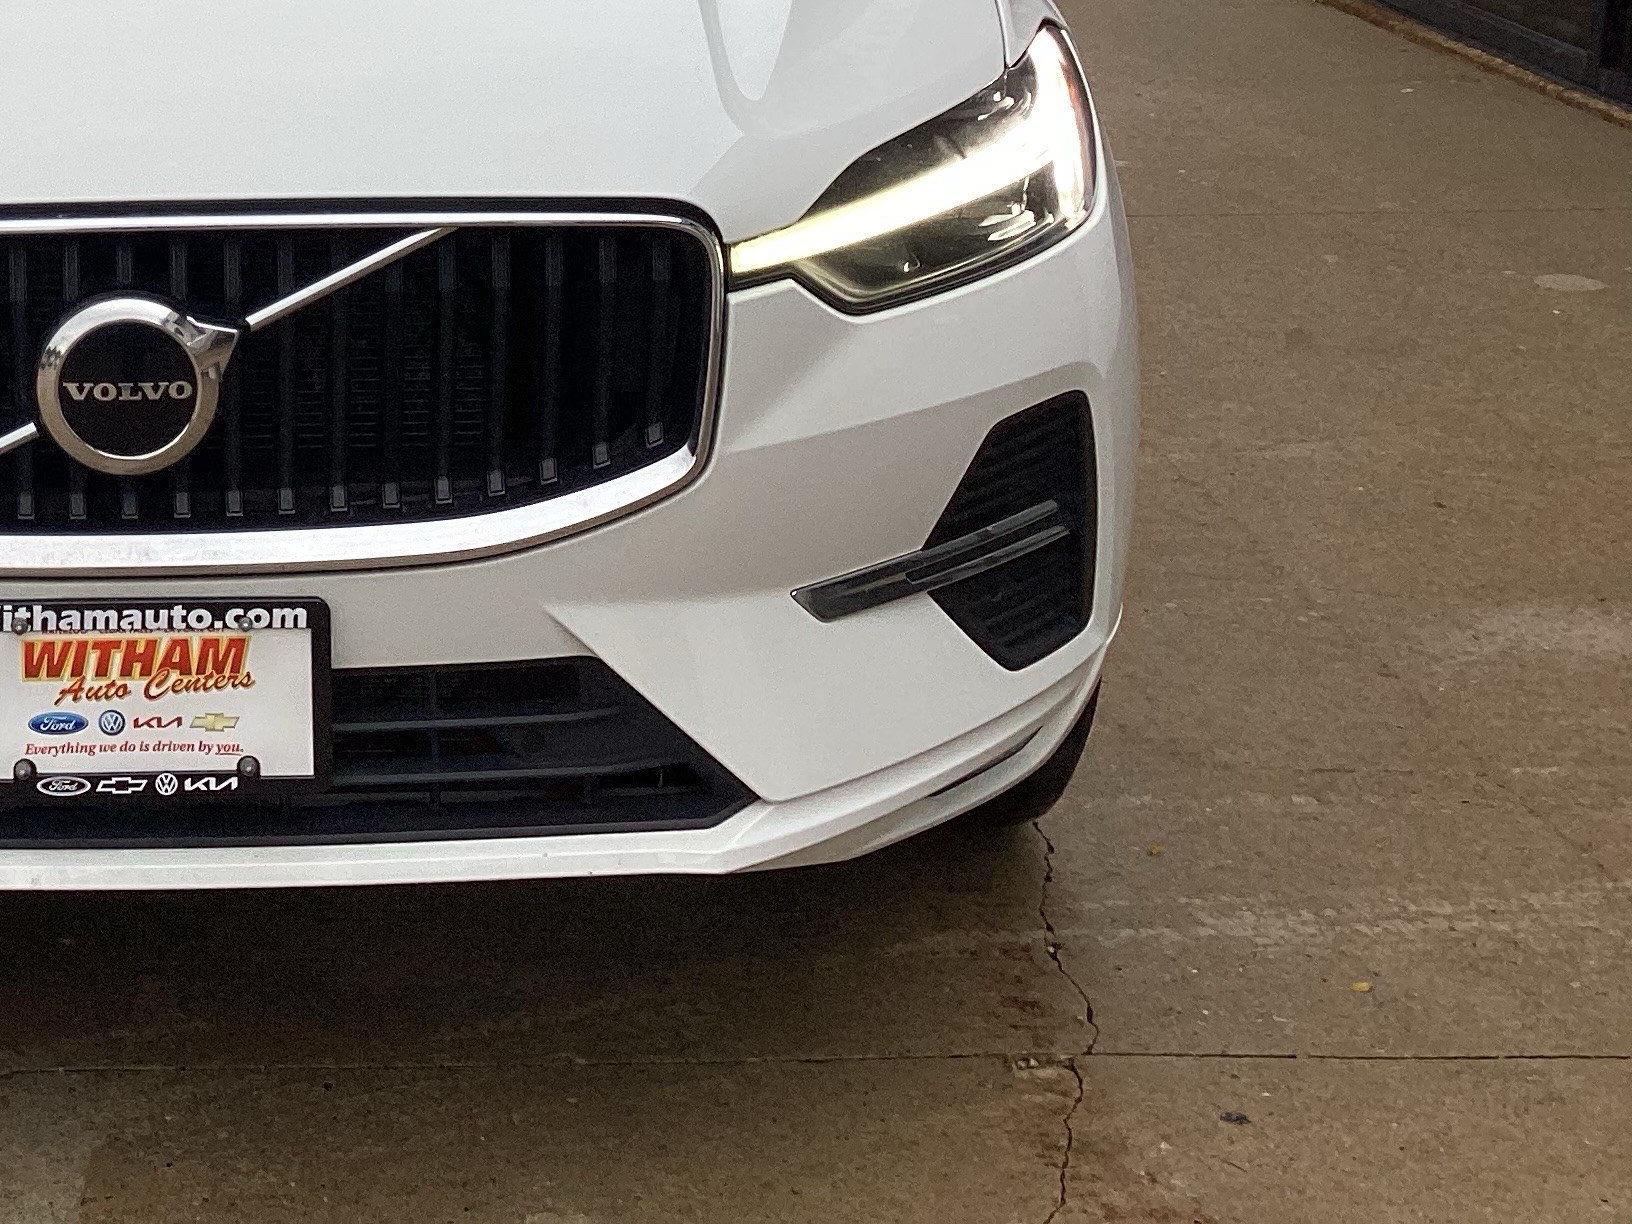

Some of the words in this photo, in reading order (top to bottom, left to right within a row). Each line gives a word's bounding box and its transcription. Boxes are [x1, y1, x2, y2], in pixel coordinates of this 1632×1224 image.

[63, 380, 193, 401] VOLVO
[22, 636, 250, 680] WITHAM
[54, 674, 131, 705] Auto
[143, 667, 255, 700] Centers
[39, 715, 76, 731] Ford
[24, 741, 96, 757] Everything
[99, 744, 117, 752] we
[119, 742, 136, 753] do
[139, 741, 150, 752] is
[152, 740, 195, 752] driven
[198, 740, 213, 754] by
